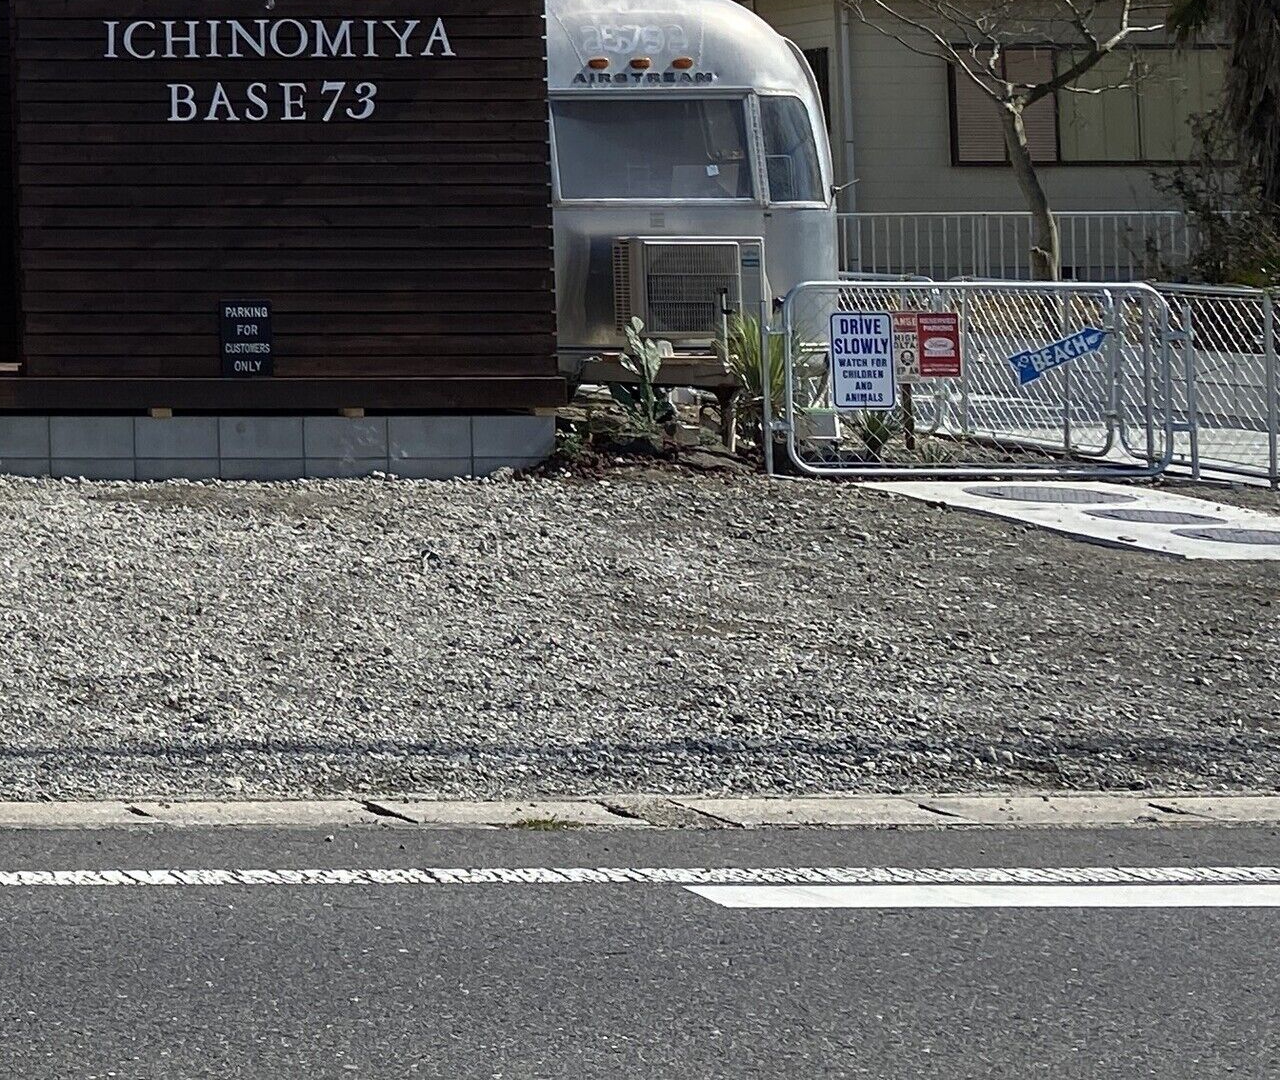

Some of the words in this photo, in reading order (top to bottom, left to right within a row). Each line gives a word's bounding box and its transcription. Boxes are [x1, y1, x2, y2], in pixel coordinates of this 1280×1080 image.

[103, 17, 457, 59] ICHINOMIYA
[572, 72, 714, 84] AIRSTREAM
[166, 81, 307, 122] BASE
[320, 80, 378, 122] 73
[225, 307, 268, 318] PARKING
[236, 324, 258, 336] FOR
[840, 318, 882, 335] DRIVE
[225, 343, 271, 353] CUSTOMERS
[834, 337, 889, 355] SLOWLY
[1030, 333, 1089, 373] BEACH
[234, 360, 262, 372] ONLY
[838, 358, 868, 368] WATCH
[871, 358, 888, 368] FOR
[842, 370, 884, 379] CHILDREN
[855, 381, 873, 390] AND
[845, 392, 884, 403] ANIMALS
